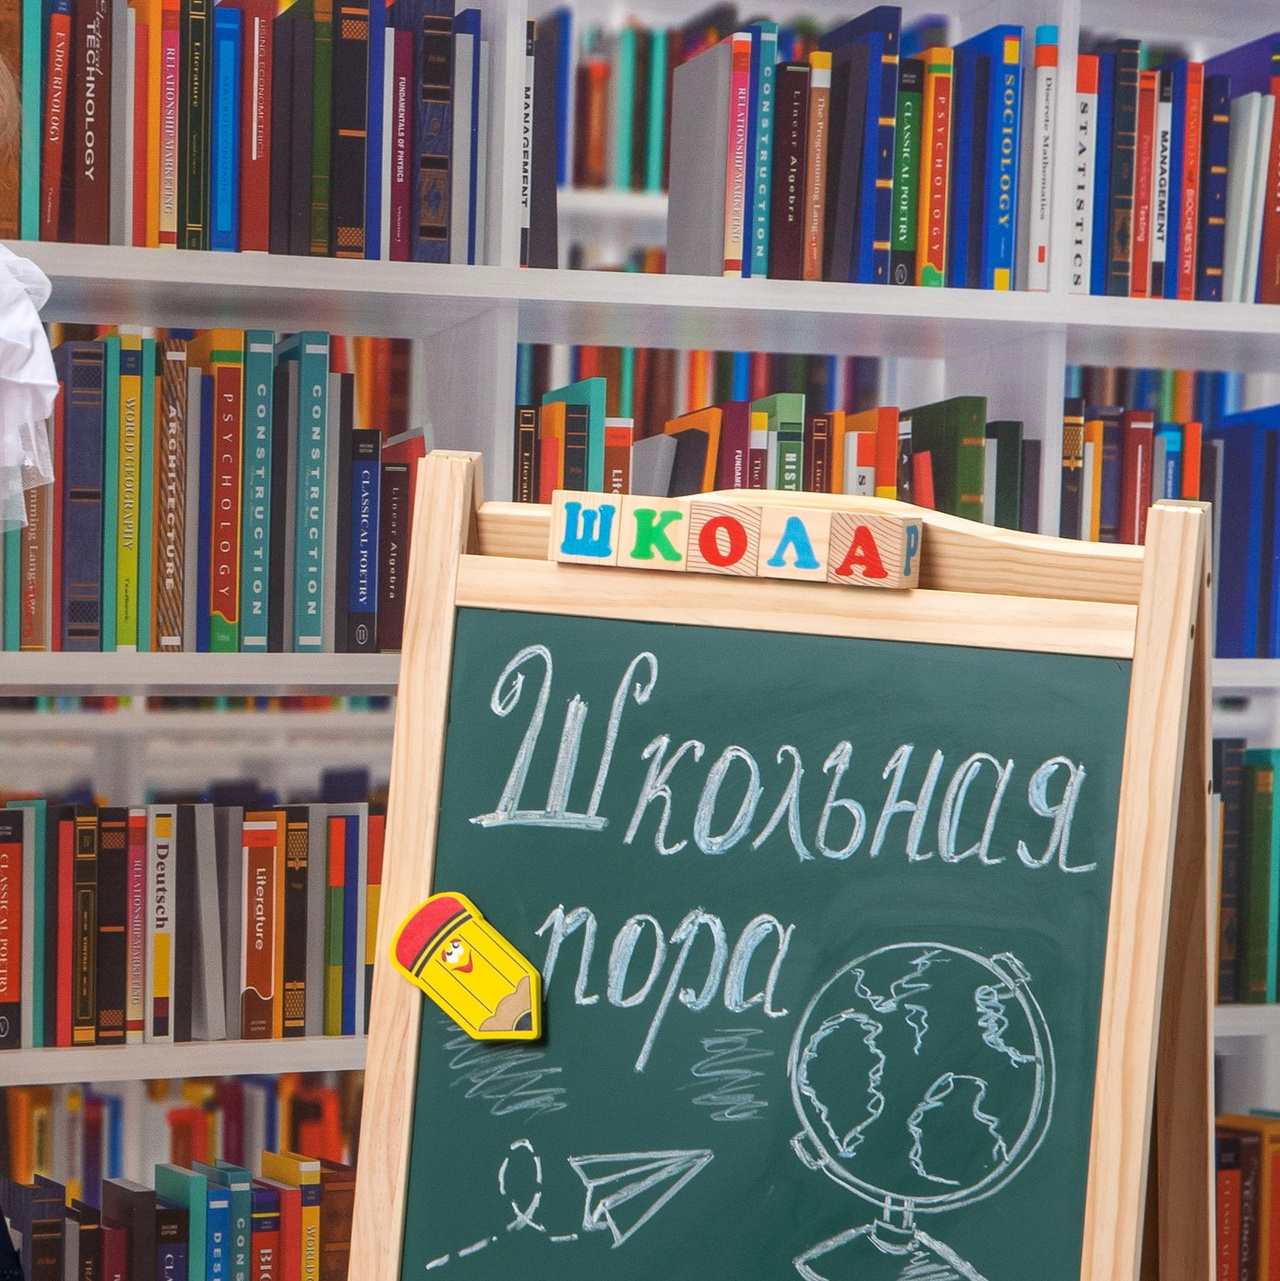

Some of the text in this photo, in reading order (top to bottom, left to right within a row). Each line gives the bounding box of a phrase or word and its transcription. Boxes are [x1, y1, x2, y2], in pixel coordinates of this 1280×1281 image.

[49, 32, 66, 143] ENDOCRINOLOGY
[84, 20, 97, 181] TECHNOLOGY
[163, 47, 176, 214] RELATIONSHIP MARKETING
[192, 42, 201, 108] Literature
[256, 19, 266, 158] USING ECONOMETRICS
[396, 77, 407, 183] FUNDAMENTALS OF PHYSICS
[732, 88, 746, 244] RELATIONSHIP MARKETING
[756, 67, 771, 257] CONSTRUCTION
[788, 91, 801, 222] Linear Algebra
[813, 96, 826, 201] The Programming
[898, 101, 913, 244] CLASSICAL POETRY
[931, 96, 946, 252] PSYCHOLOGY
[998, 74, 1016, 228] SOCIOLOGY
[1039, 77, 1053, 220] Discrete Mathematics
[1072, 101, 1089, 286] STATISTICS
[1156, 130, 1169, 244] MANAGEMENT
[1183, 189, 1195, 275] BIOCHEMISTRY
[121, 397, 136, 551] WORLD GEOGRAPHY
[164, 404, 179, 590] ARCHITECTURE
[218, 393, 234, 597] PSYCHOLOGY
[252, 384, 267, 615] CONSTRUCTION
[306, 385, 323, 615] CONSTRUCTION
[358, 470, 371, 605] CLASSICAL POETRY
[388, 487, 400, 599] Linear Algebra
[561, 501, 888, 579] ШКОЛА
[469, 644, 1098, 873] Школьная
[0, 854, 9, 935] CLASSICAL
[131, 860, 143, 1006] RELATIONSHIP MARKETING
[155, 844, 170, 929] Deutsch
[255, 868, 267, 951] Literature
[534, 903, 797, 1072] пора
[305, 1225, 317, 1274] WORLD
